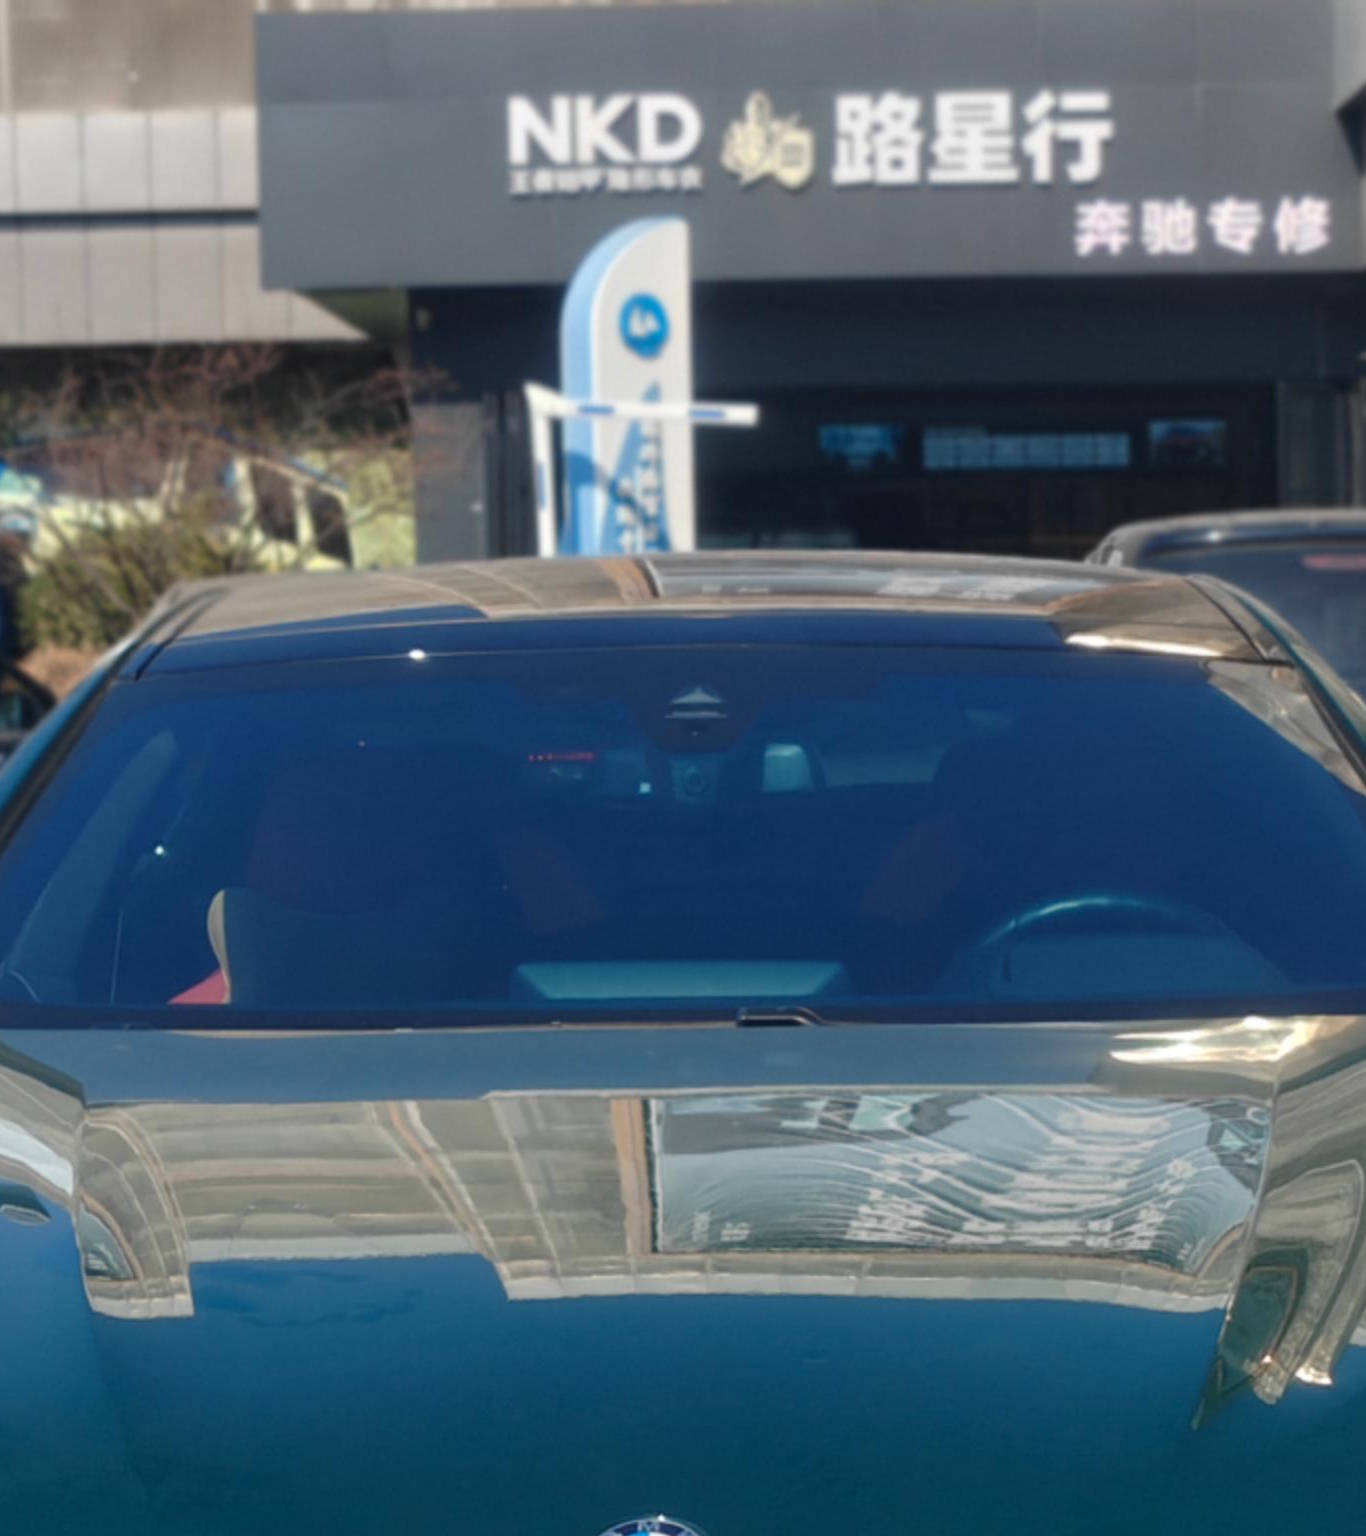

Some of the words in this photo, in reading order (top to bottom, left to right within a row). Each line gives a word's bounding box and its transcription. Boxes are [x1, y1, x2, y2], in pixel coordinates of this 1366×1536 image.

[508, 93, 702, 166] NKD
[832, 90, 1114, 185] 路星行
[1075, 196, 1331, 256] 奔驰专修
